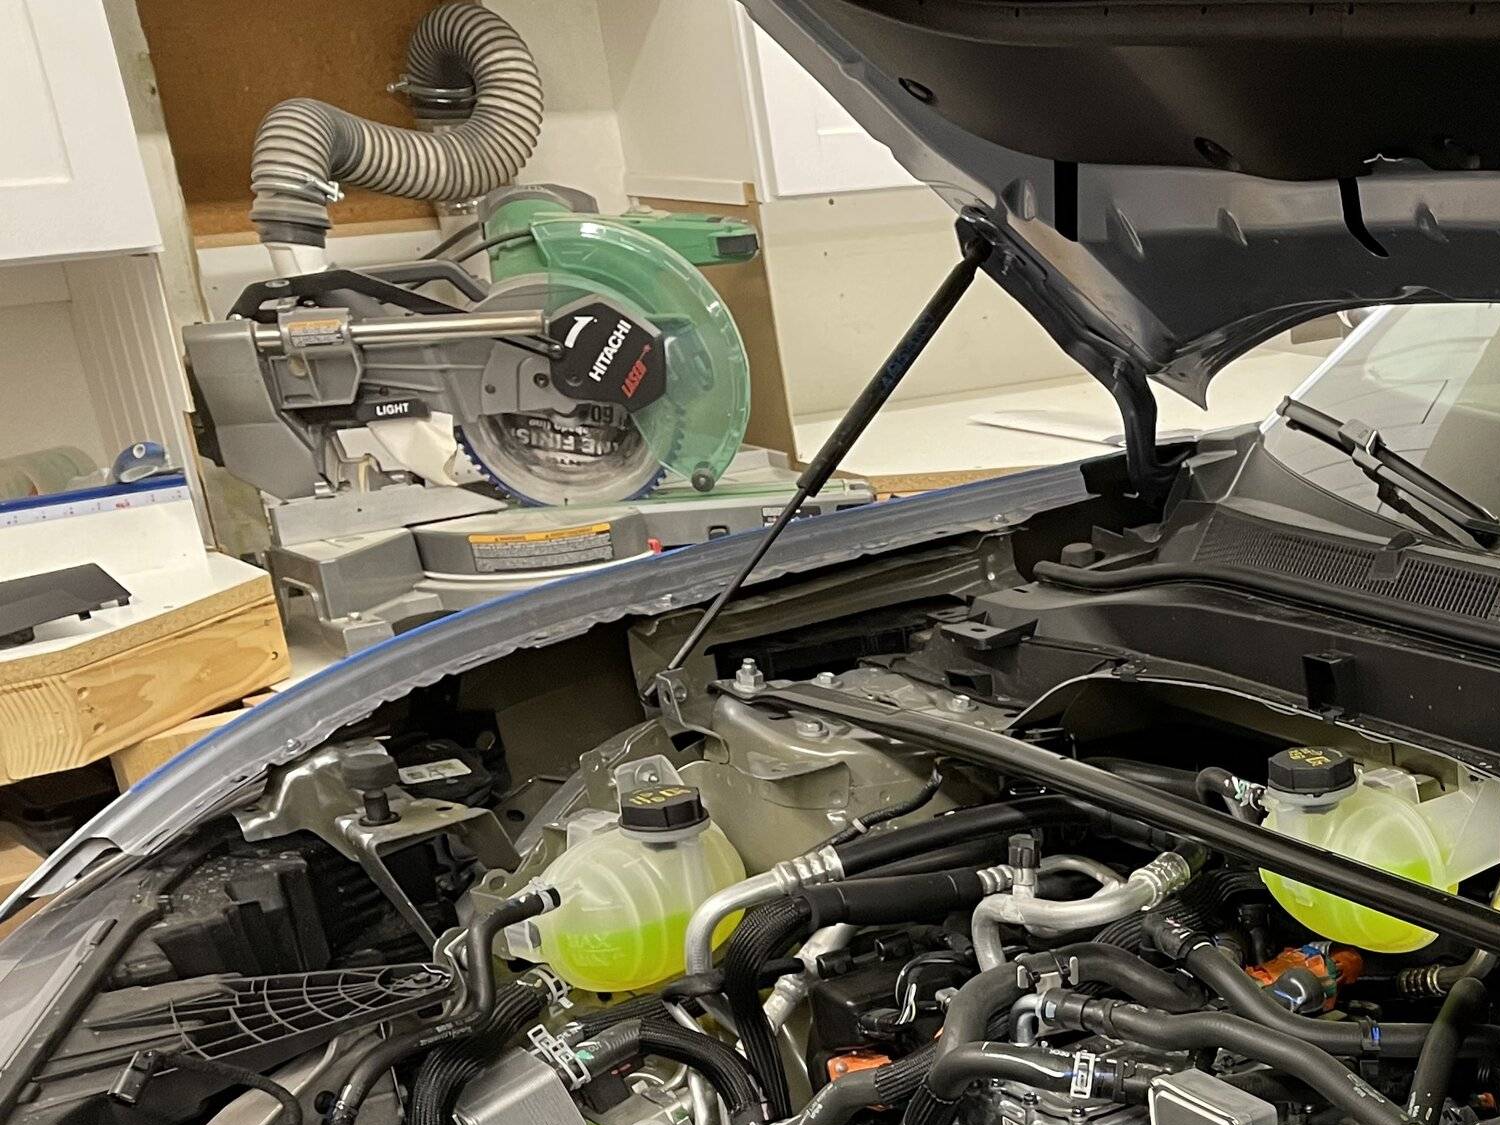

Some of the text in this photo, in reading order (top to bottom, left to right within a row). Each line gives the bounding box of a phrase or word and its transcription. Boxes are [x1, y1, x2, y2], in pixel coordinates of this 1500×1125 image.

[588, 319, 632, 382] HITACHI
[621, 359, 648, 398] LASER
[375, 402, 410, 416] LIGHT
